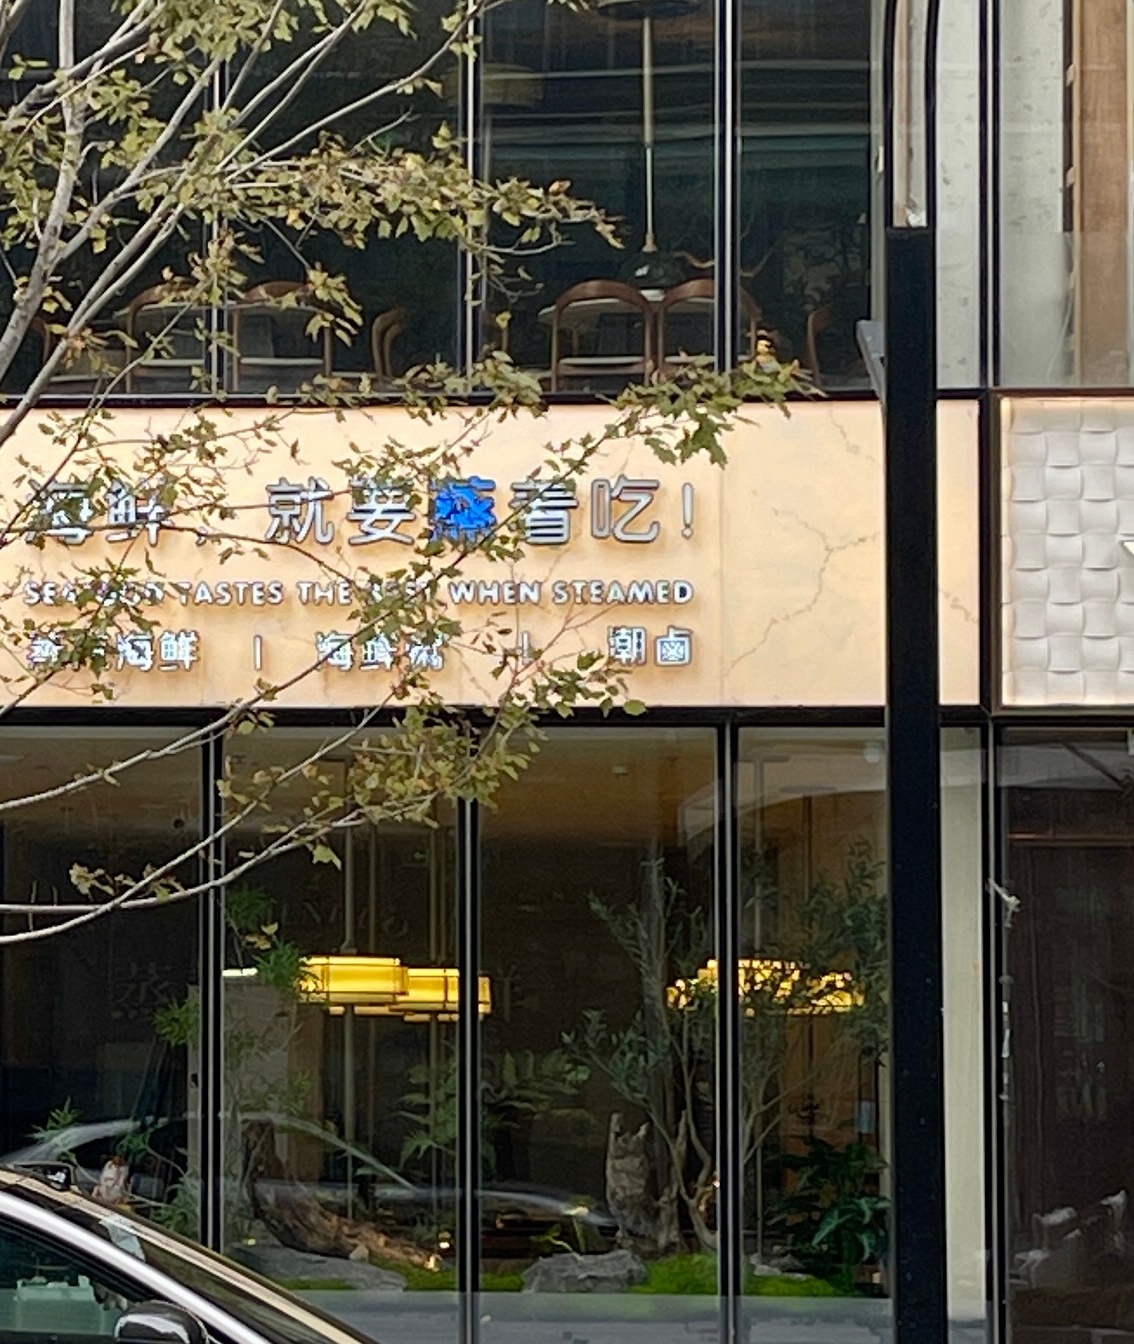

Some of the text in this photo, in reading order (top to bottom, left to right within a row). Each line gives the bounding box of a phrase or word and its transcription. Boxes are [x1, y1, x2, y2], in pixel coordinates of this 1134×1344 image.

[24, 581, 164, 606] SEAOOD
[176, 581, 284, 606] TASTES
[297, 581, 352, 605] THE
[449, 581, 542, 605] WHEN
[552, 581, 694, 605] STEAMED
